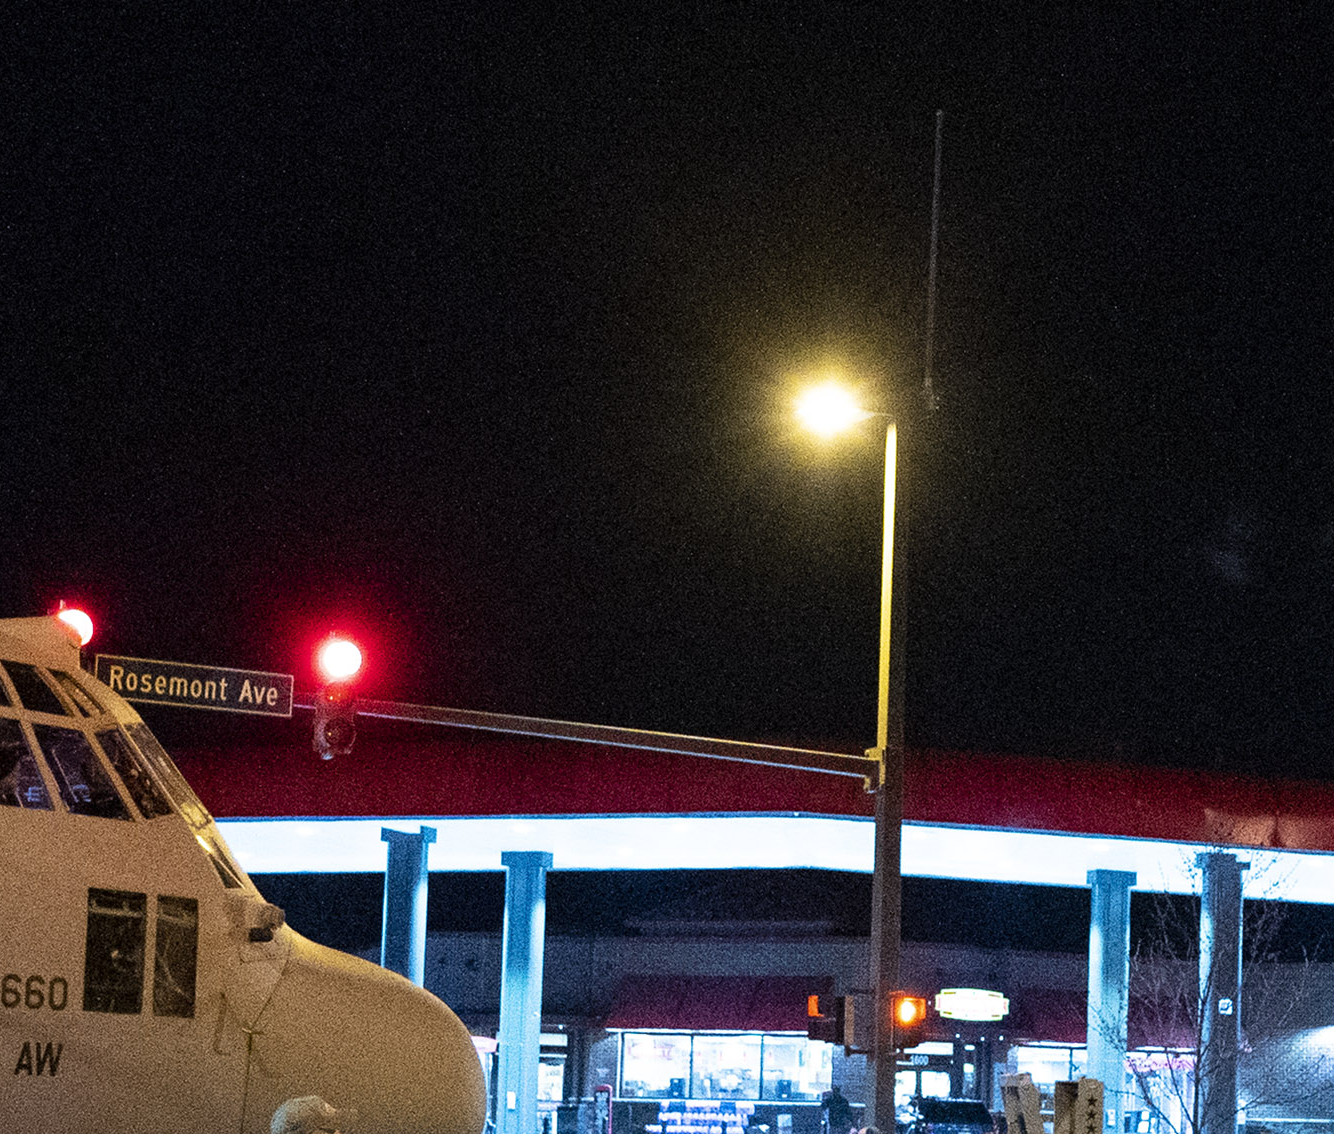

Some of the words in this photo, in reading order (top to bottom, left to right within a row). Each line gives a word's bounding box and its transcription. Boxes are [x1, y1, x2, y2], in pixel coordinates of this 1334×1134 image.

[109, 665, 228, 701] Rosemont
[238, 679, 278, 707] Ave
[14, 1041, 64, 1077] AW
